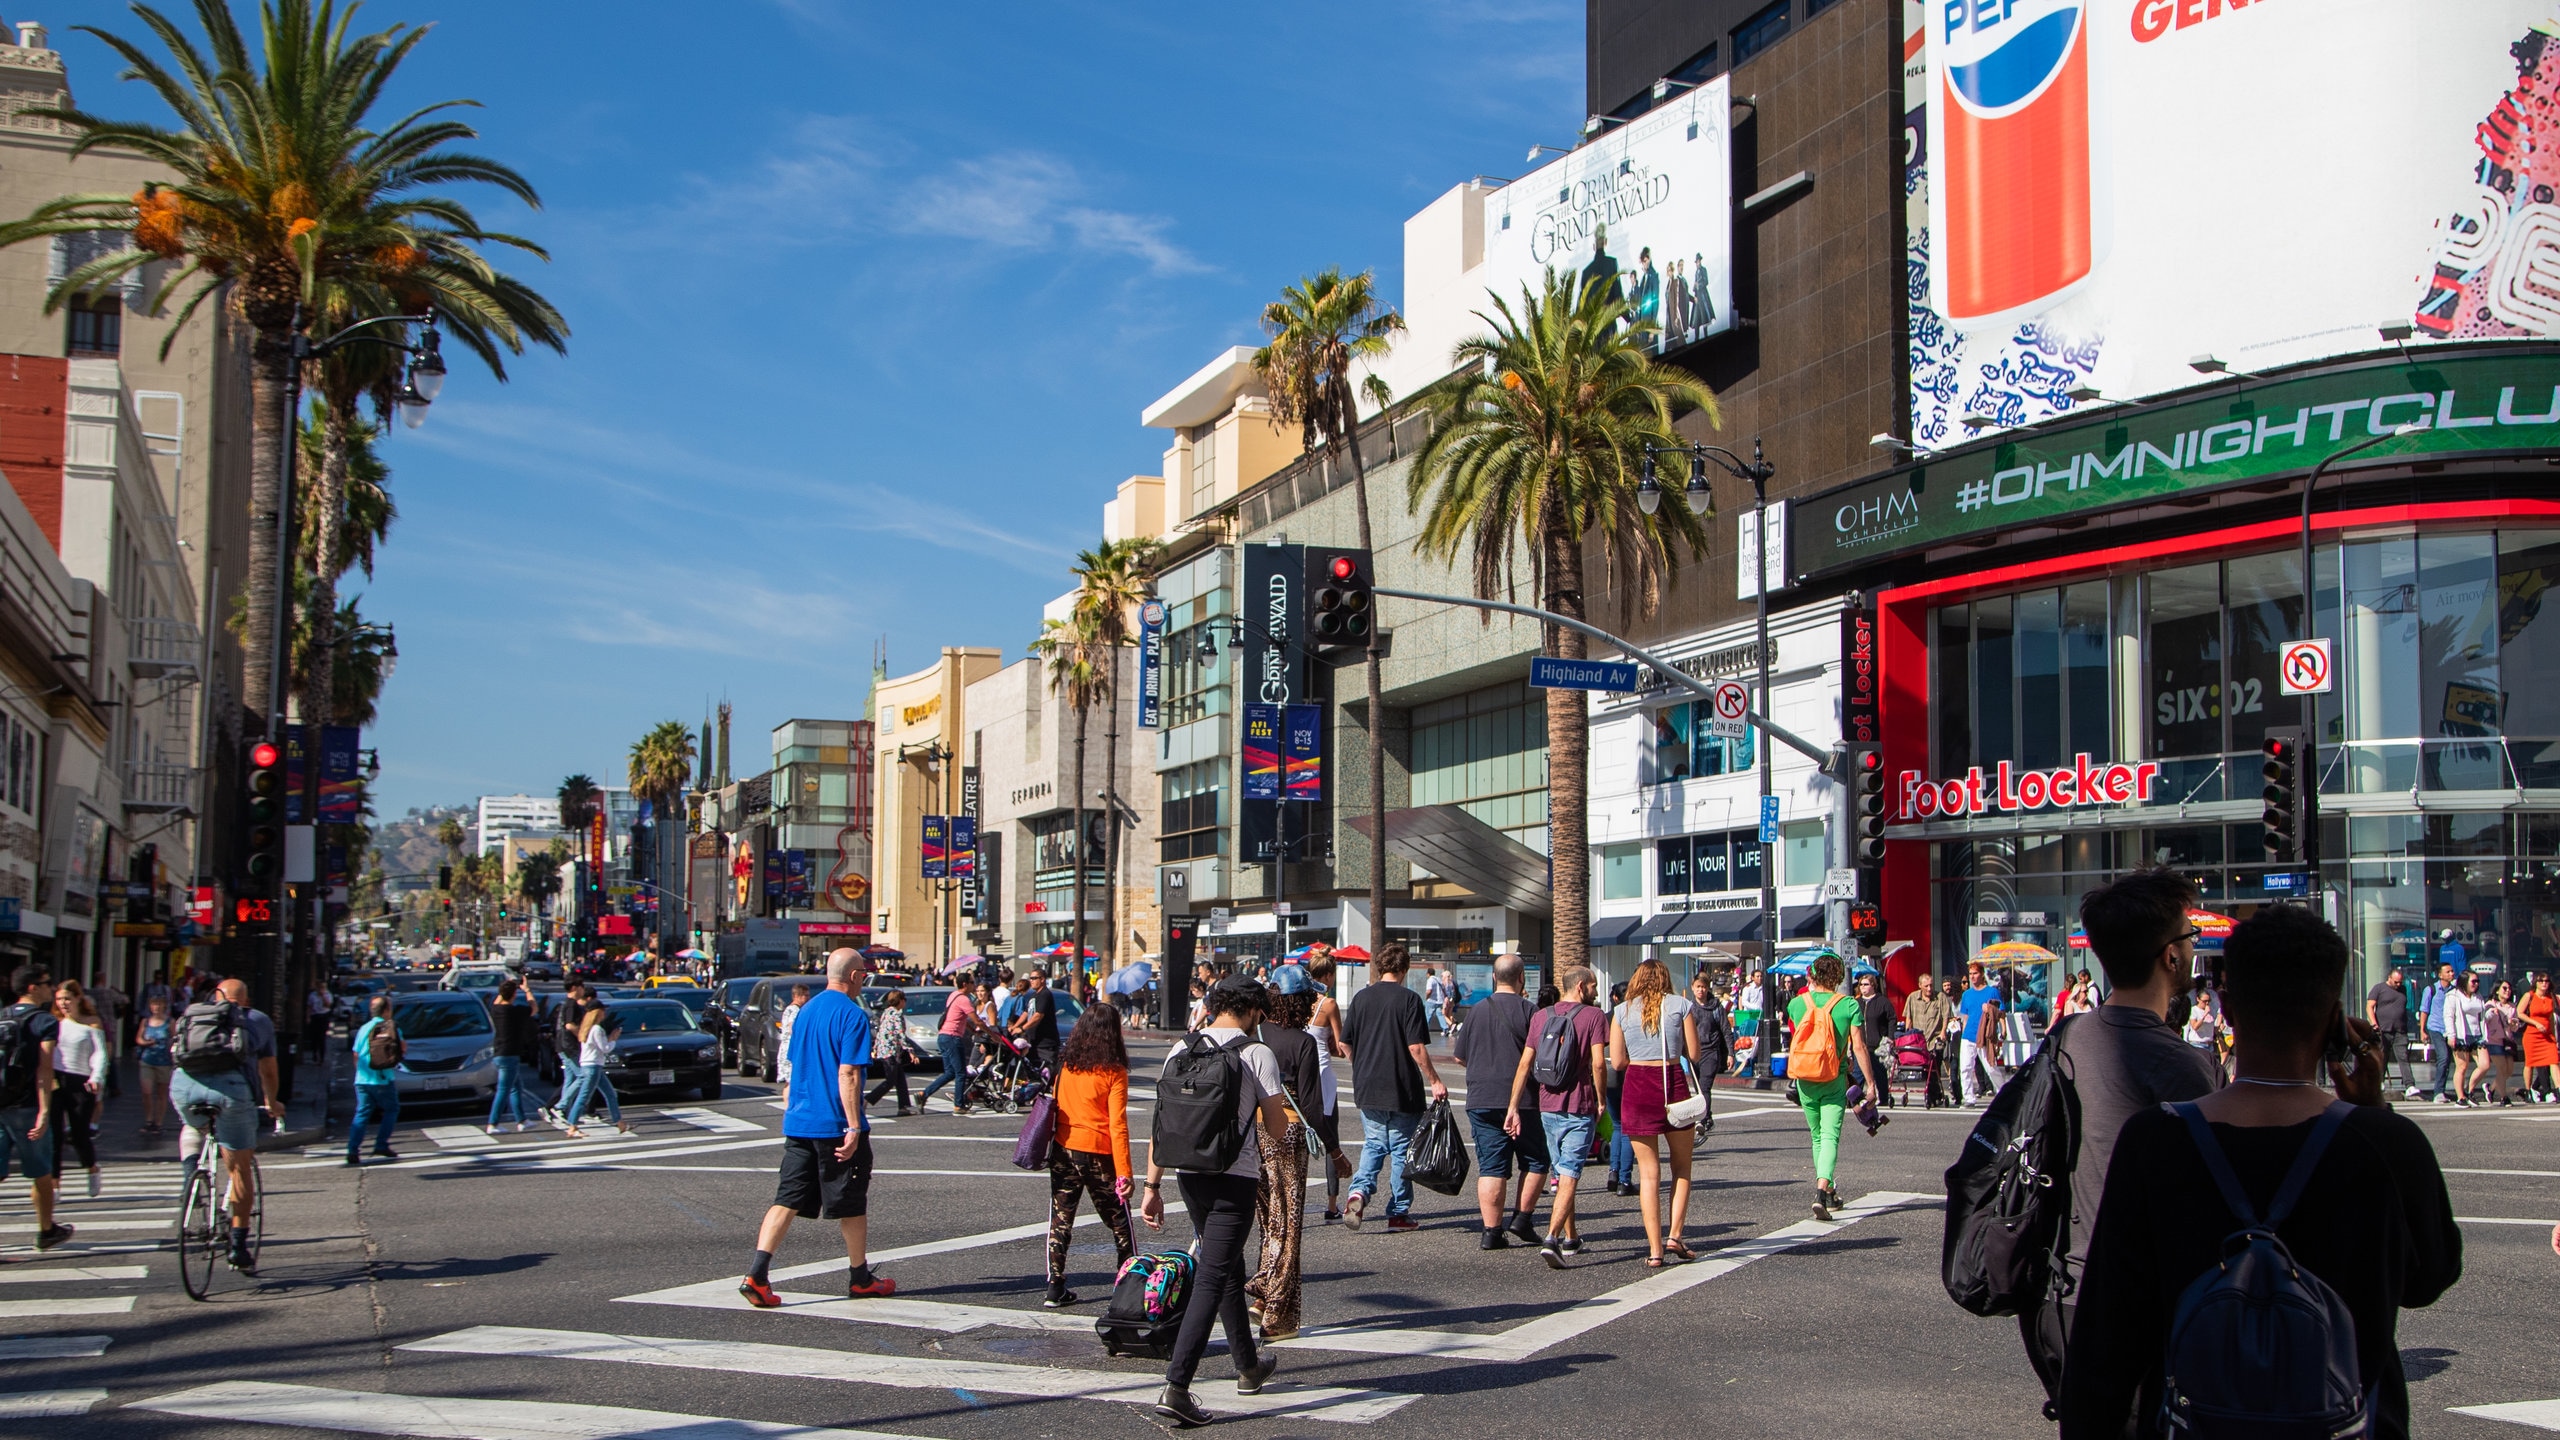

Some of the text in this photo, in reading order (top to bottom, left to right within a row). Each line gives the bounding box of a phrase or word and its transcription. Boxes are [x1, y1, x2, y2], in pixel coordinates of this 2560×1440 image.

[1557, 203, 1571, 219] THE
[1637, 165, 1650, 181] OF
[1531, 174, 1670, 264] GRINDELWALD
[1836, 488, 1918, 532] OHM
[1836, 516, 1919, 544] NIGHTCLUB
[1147, 632, 1159, 656] PLAY
[1851, 617, 1871, 705] Locker
[1146, 667, 1158, 697] DRINK
[1541, 664, 1603, 685] Highland
[1609, 669, 1627, 684] Av
[1145, 708, 1158, 726] EAT
[1715, 721, 1744, 734] ON RED
[1853, 714, 1872, 742] ot
[1250, 728, 1272, 736] FEST
[1012, 781, 1052, 805] SEPHORA
[1900, 752, 2161, 819] Foot Locker
[1665, 860, 1687, 876] LIVE
[1698, 855, 1727, 873] YOUR
[1739, 850, 1761, 868] LIFE
[1170, 873, 1183, 887] M
[1828, 884, 1840, 896] OK
[1863, 909, 1877, 928] 26
